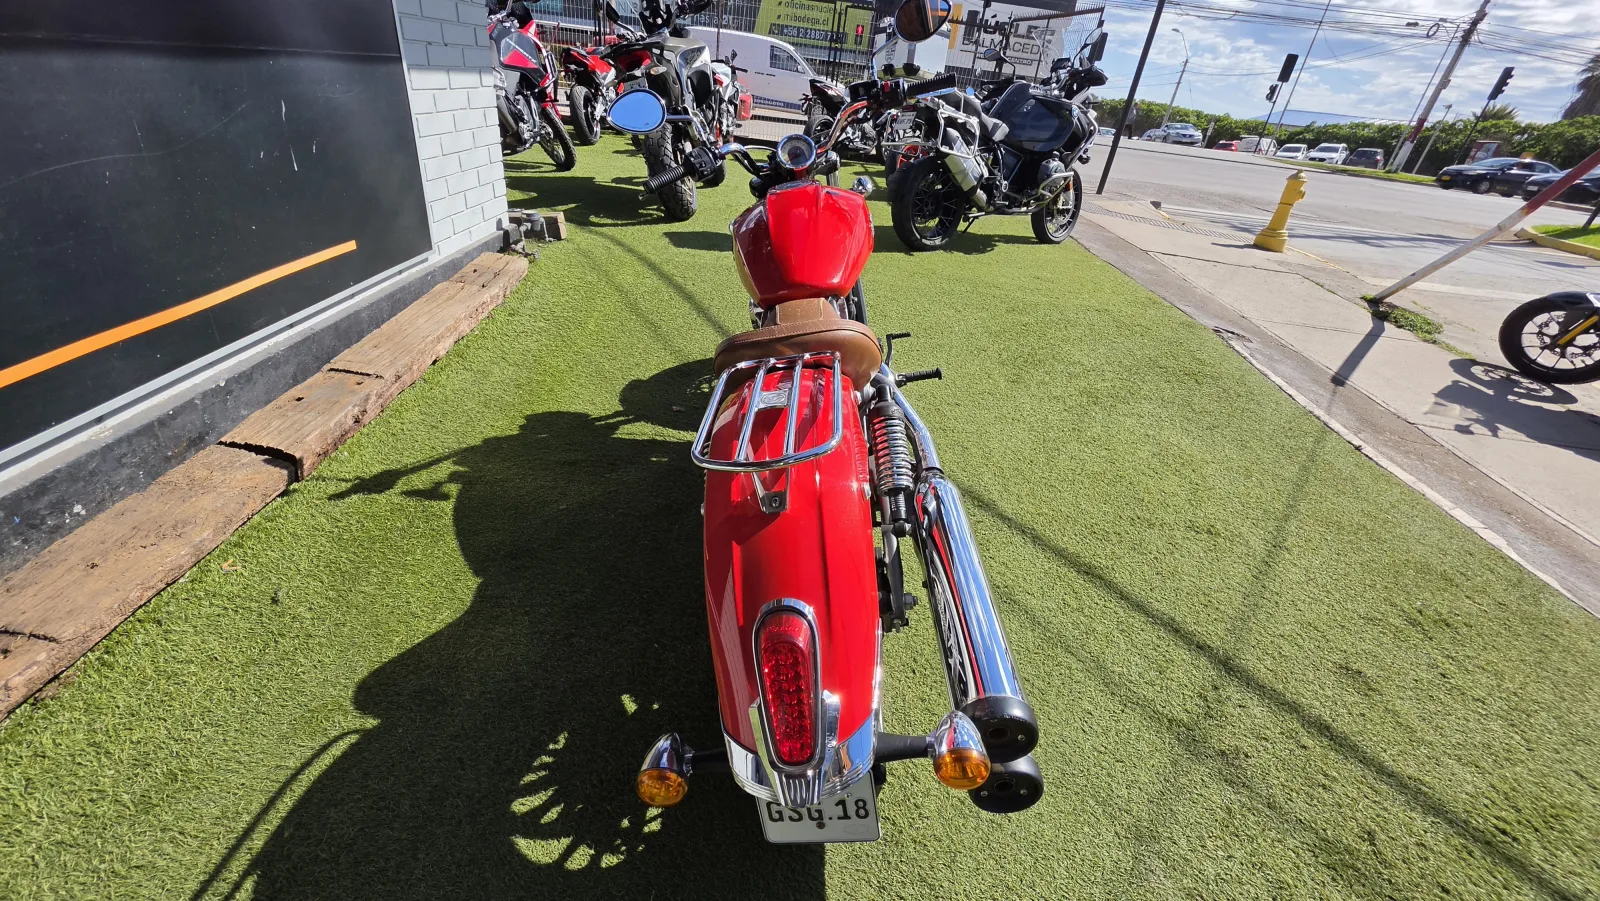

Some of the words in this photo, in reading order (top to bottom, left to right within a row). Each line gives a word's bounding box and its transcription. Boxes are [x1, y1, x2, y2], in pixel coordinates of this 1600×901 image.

[785, 0, 847, 15] oficinasnucle.c
[784, 13, 829, 26] mibodega.cl
[962, 36, 1049, 57] BALMACED
[766, 799, 869, 822] GSG.18
